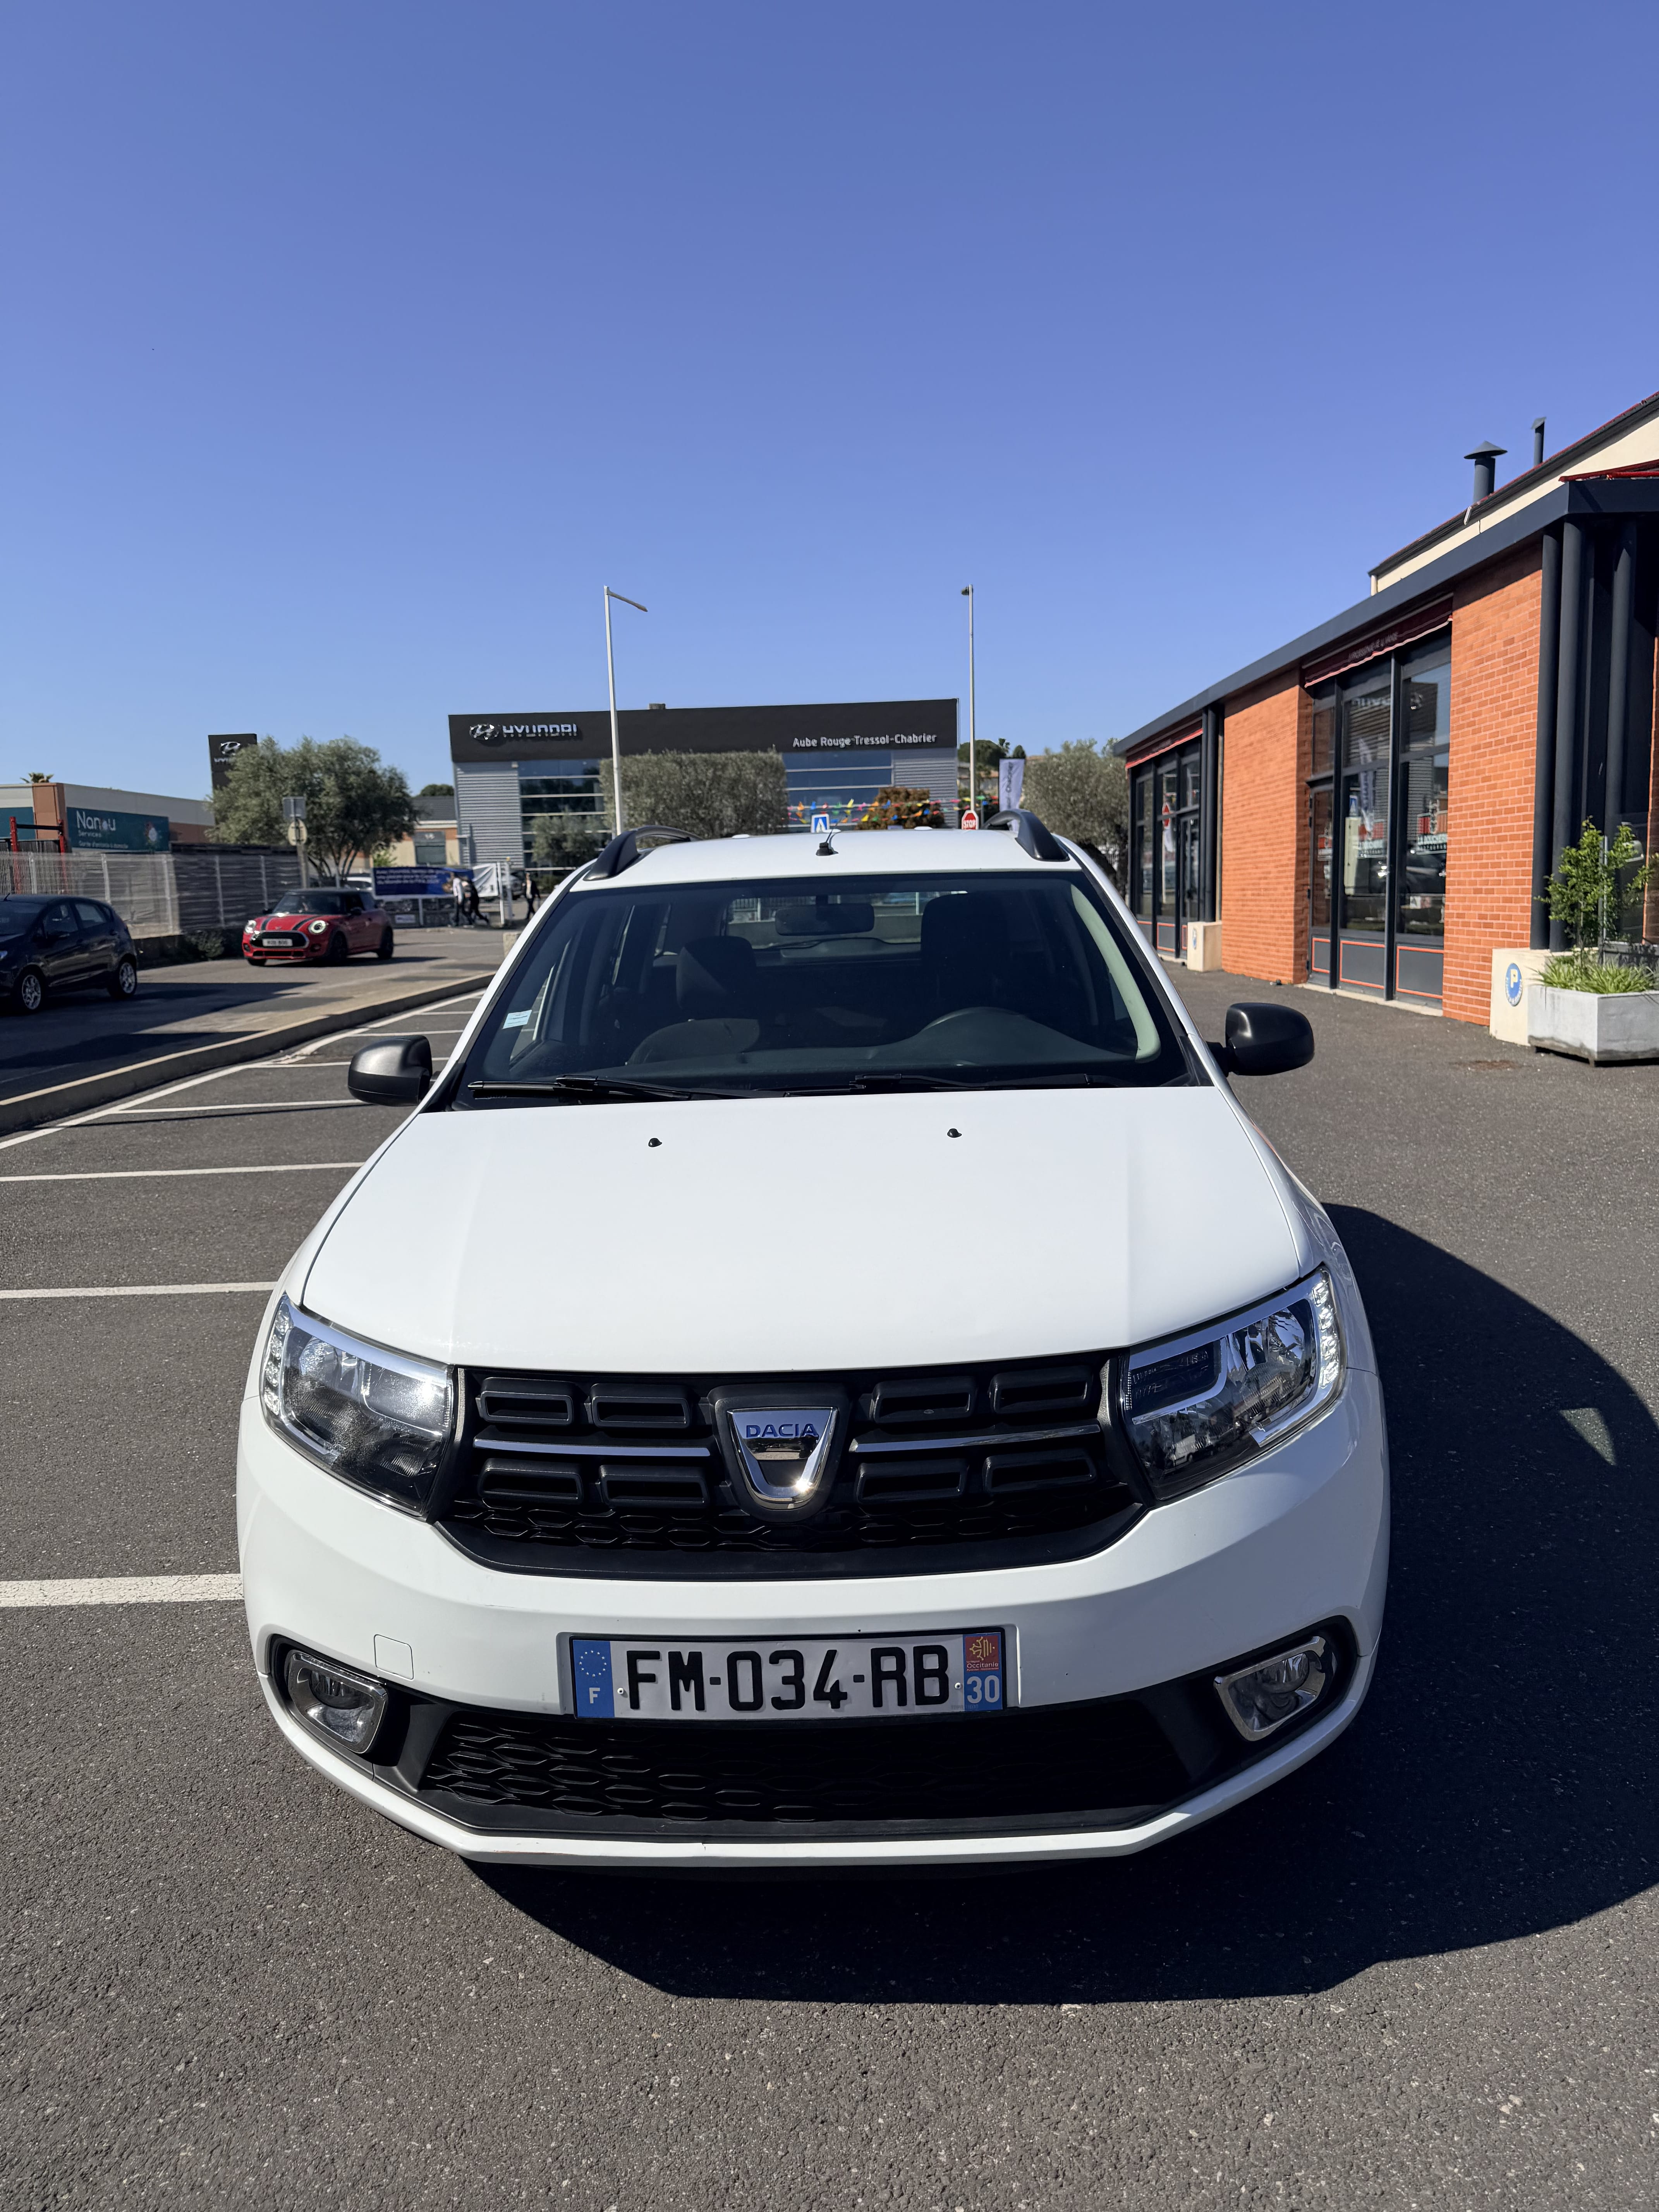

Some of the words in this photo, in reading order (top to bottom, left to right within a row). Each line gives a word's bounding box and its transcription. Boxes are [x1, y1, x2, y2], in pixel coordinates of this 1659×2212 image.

[503, 724, 577, 737] HYUNDAI
[793, 737, 817, 748] Aube
[963, 819, 975, 828] STOP
[1510, 969, 1518, 988] P
[746, 1423, 819, 1438] DACIA
[626, 1645, 950, 1711] FM-034-RB
[589, 1687, 600, 1704] F
[967, 1675, 1000, 1704] 30
